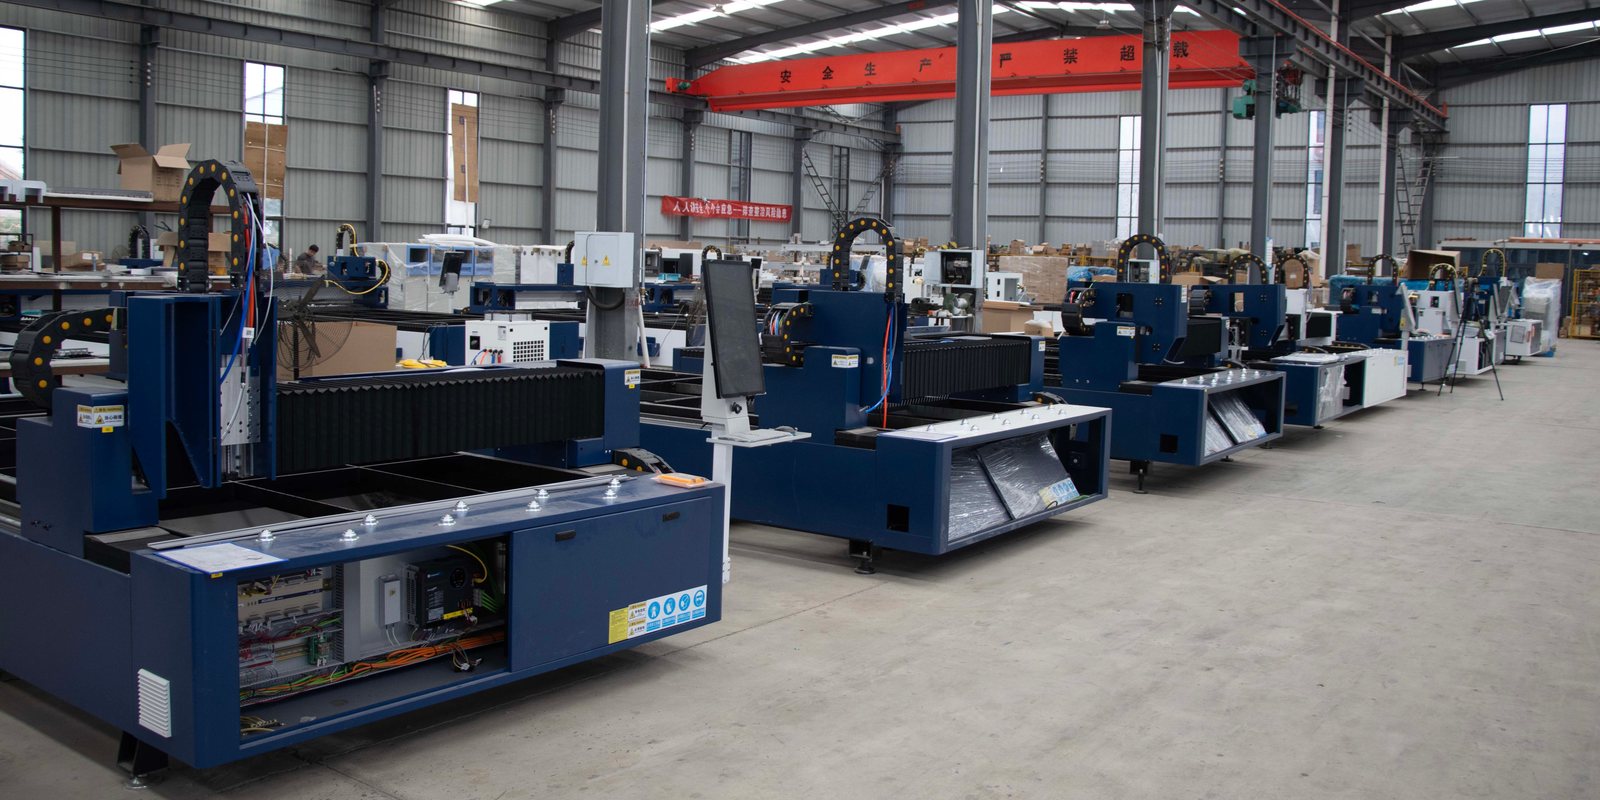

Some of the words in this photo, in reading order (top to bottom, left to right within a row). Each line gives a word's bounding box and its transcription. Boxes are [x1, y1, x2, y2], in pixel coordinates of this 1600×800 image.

[780, 58, 932, 83] 安全生产
[999, 41, 1189, 68] 严禁超载
